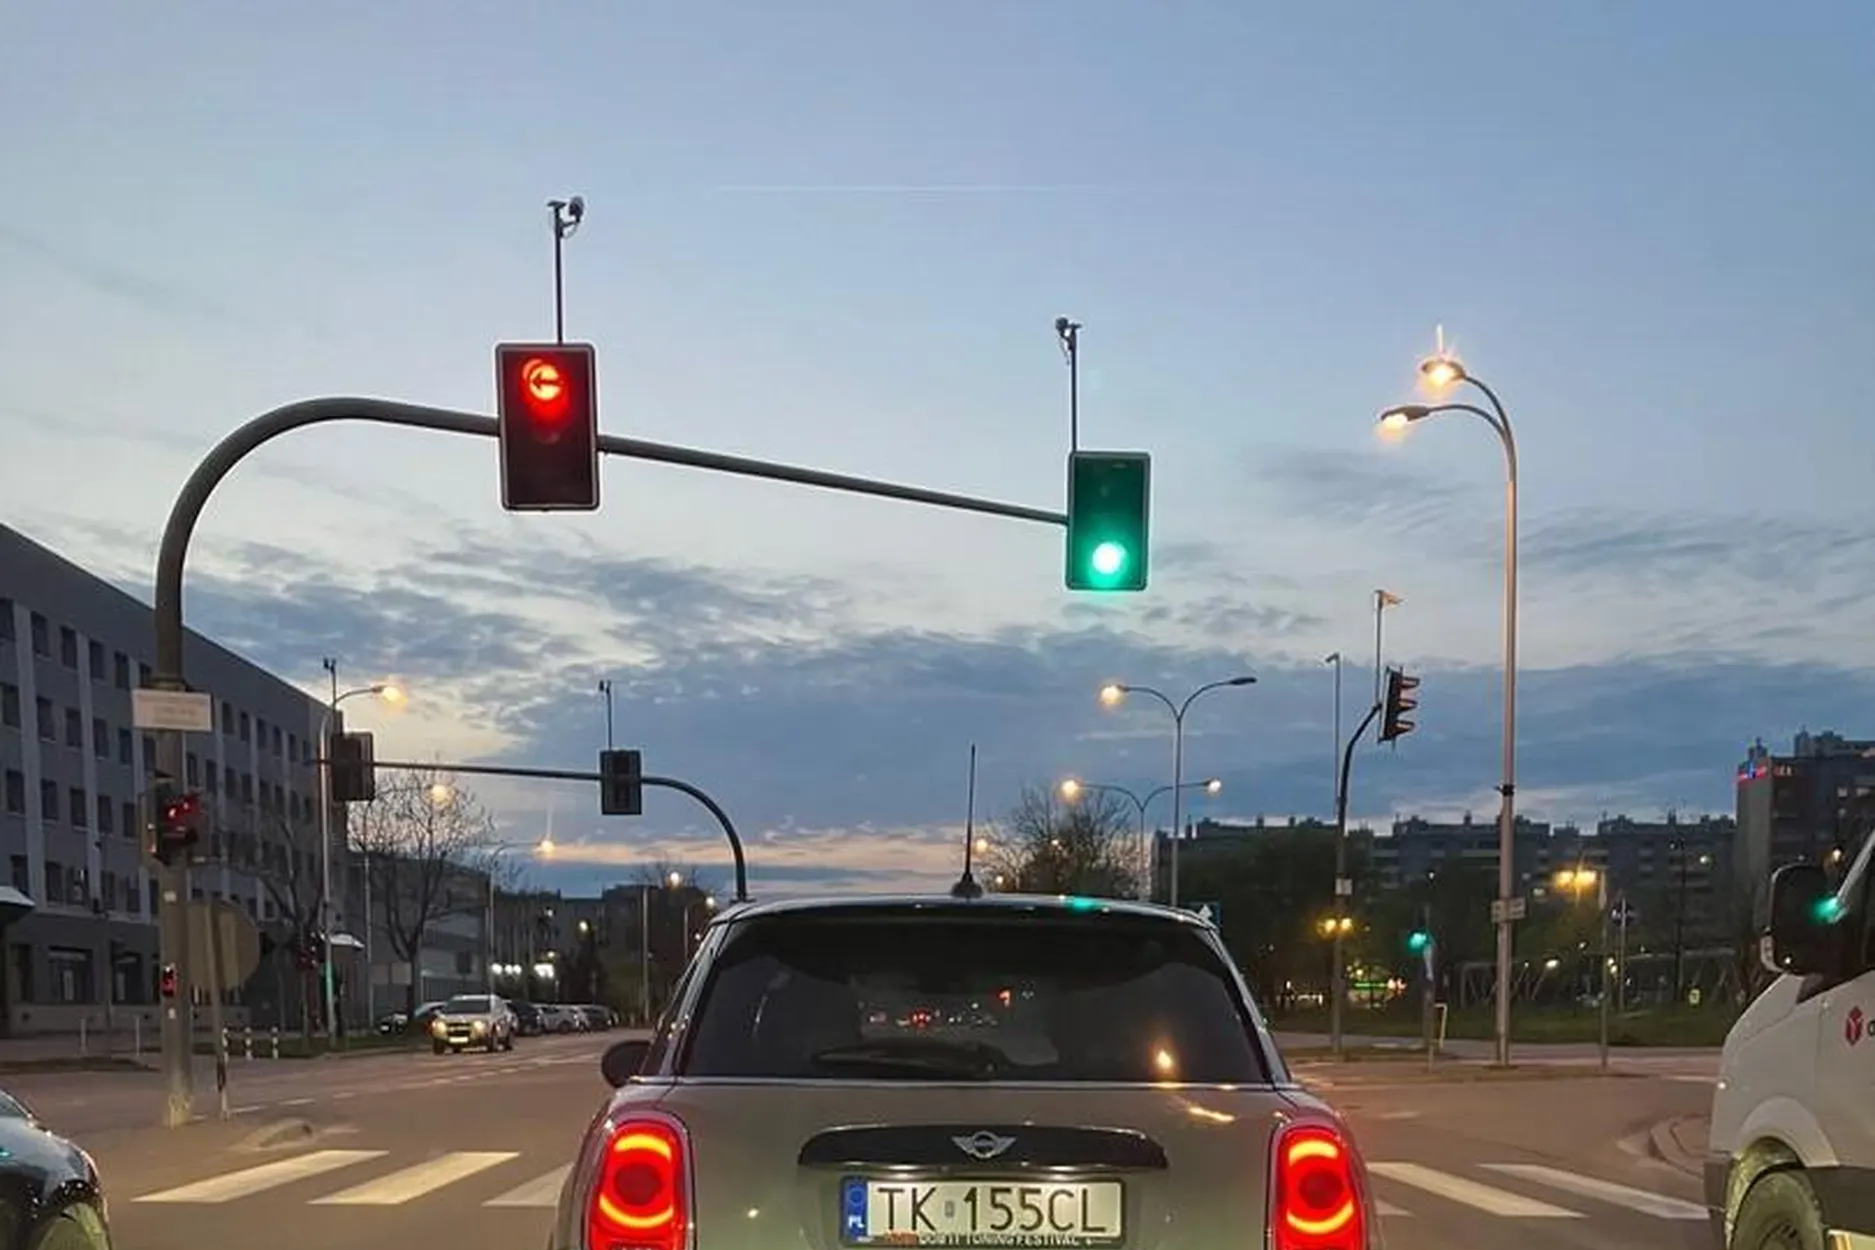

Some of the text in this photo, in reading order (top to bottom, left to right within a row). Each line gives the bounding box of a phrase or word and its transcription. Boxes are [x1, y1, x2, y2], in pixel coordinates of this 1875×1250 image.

[848, 1215, 865, 1228] PL
[877, 1186, 1107, 1232] TK 155CL
